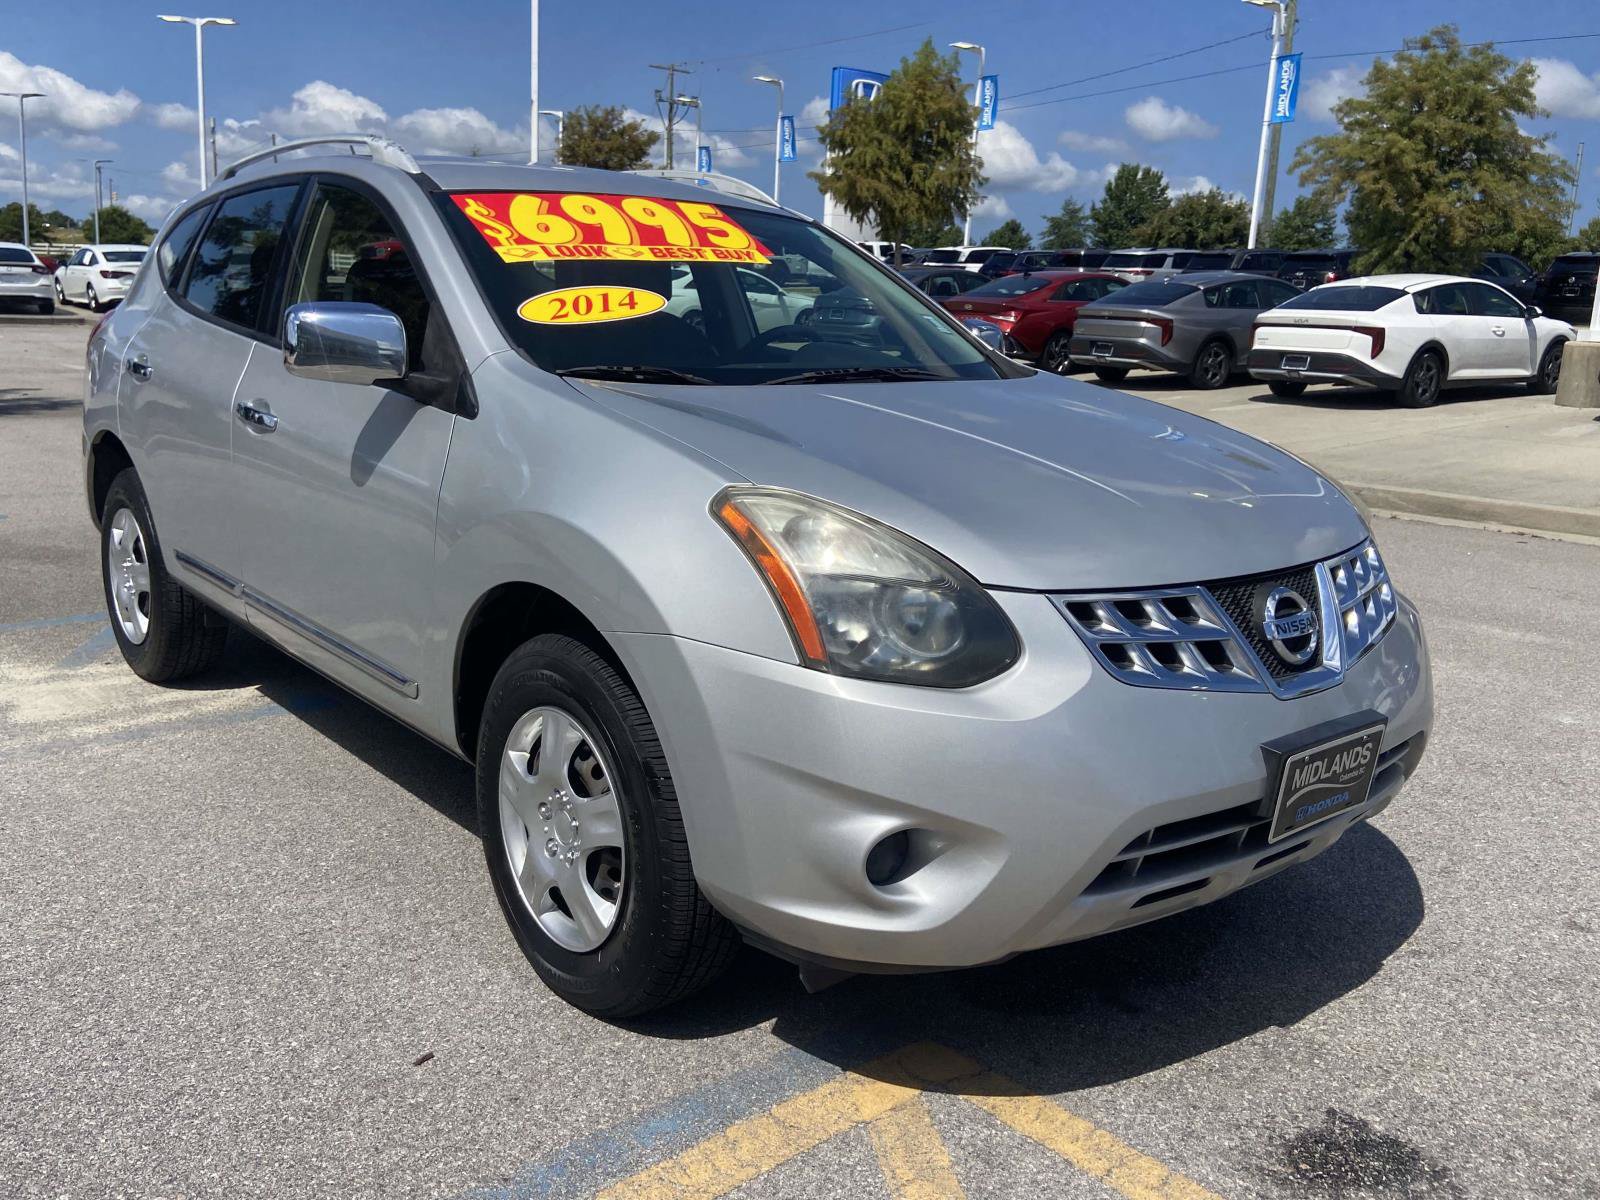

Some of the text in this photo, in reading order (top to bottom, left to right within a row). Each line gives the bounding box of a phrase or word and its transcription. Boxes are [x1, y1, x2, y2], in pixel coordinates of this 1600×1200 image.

[1277, 60, 1291, 117] MIDLANDS
[464, 194, 756, 250] $6995
[540, 245, 757, 262] LOOK BEST BUY
[548, 290, 638, 320] 2014
[1292, 743, 1372, 790] MIDLANDS
[1307, 791, 1349, 816] HONDA
